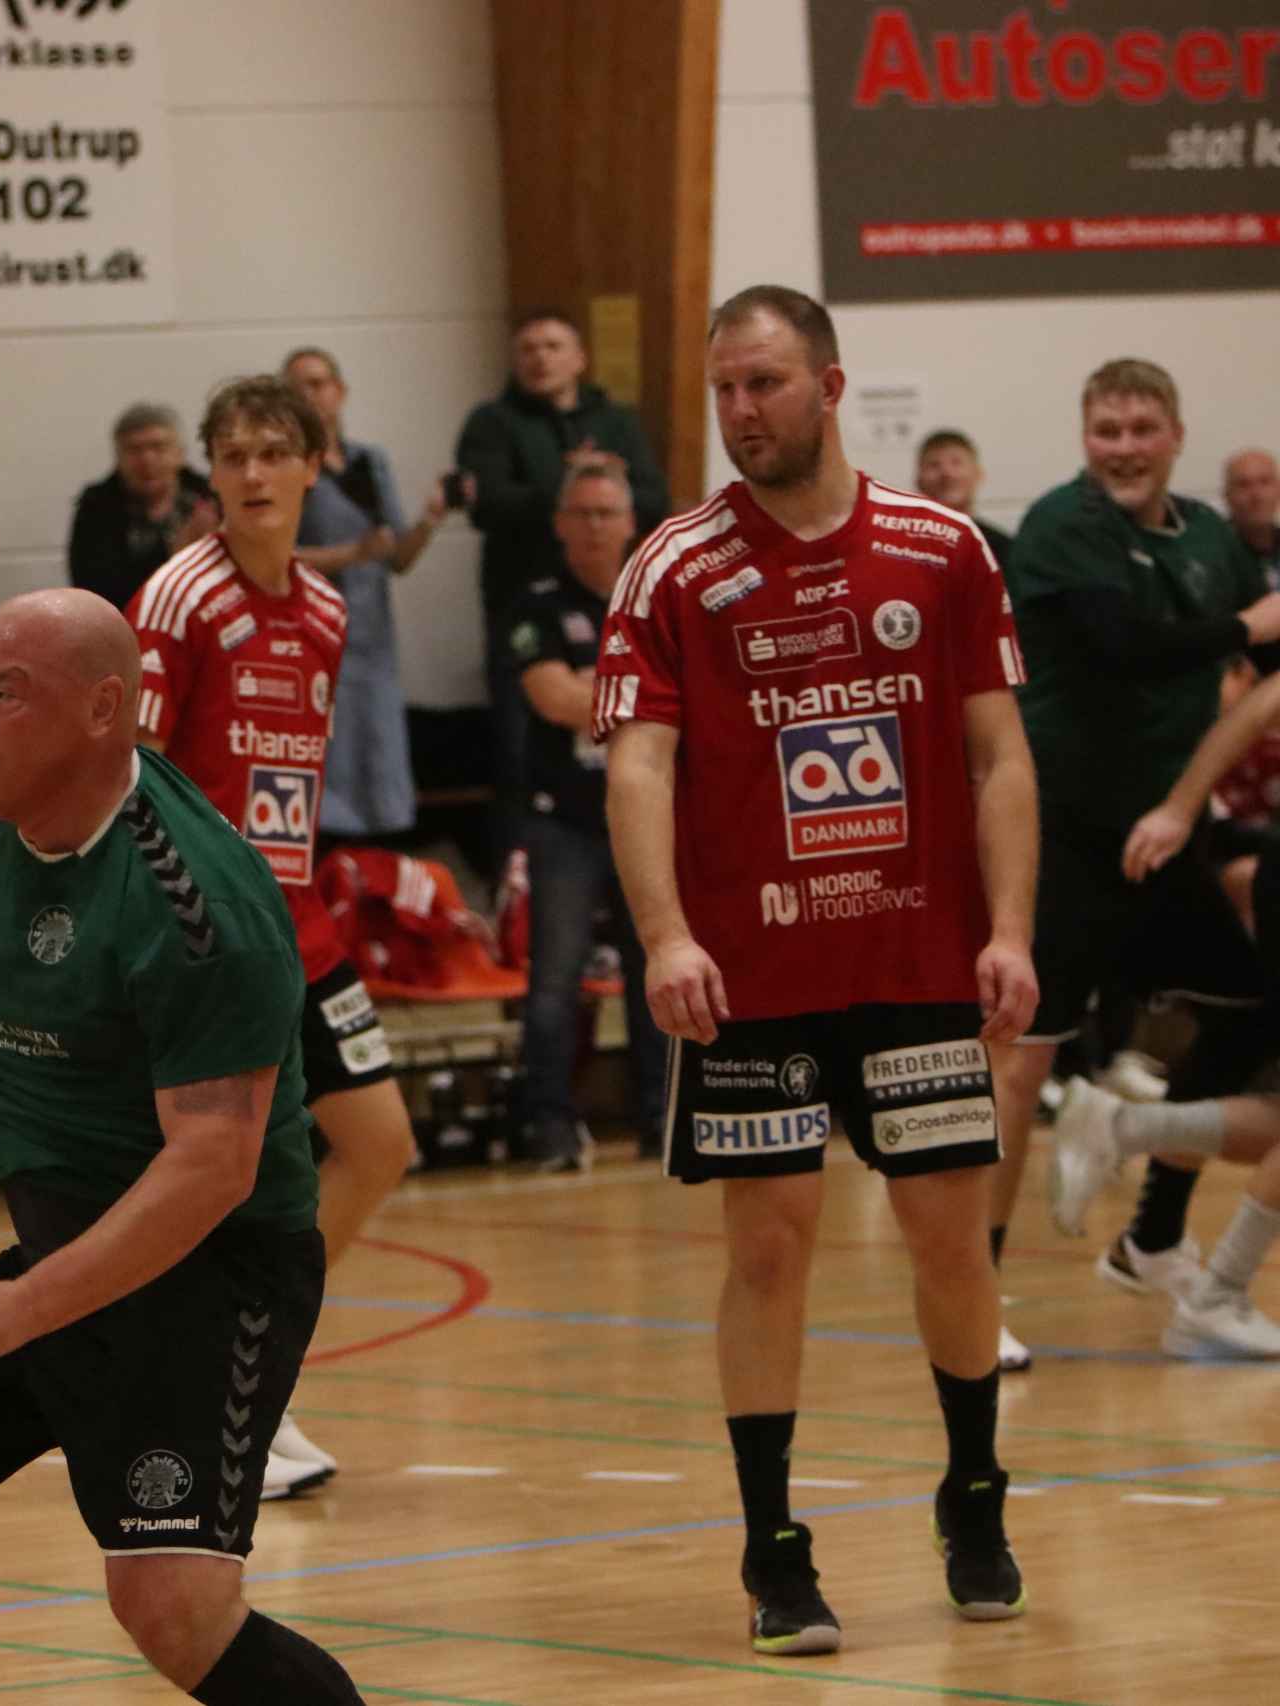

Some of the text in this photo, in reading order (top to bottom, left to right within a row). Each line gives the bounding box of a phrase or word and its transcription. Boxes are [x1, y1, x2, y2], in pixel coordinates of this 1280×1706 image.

[872, 512, 961, 543] KENTAUR
[674, 536, 750, 589] KENTAUR
[748, 673, 924, 728] thansen
[228, 720, 325, 762] thanse
[801, 817, 899, 846] DANMARK
[809, 868, 884, 898] NORDIC
[702, 1058, 777, 1074] Fredericia
[872, 1047, 981, 1079] FREDERICIA
[702, 1074, 777, 1089] Kommune
[875, 1074, 986, 1099] SHIPPING
[696, 1108, 828, 1149] PHILIPS
[904, 1109, 992, 1132] Crossbridge
[137, 1514, 200, 1532] hummel
